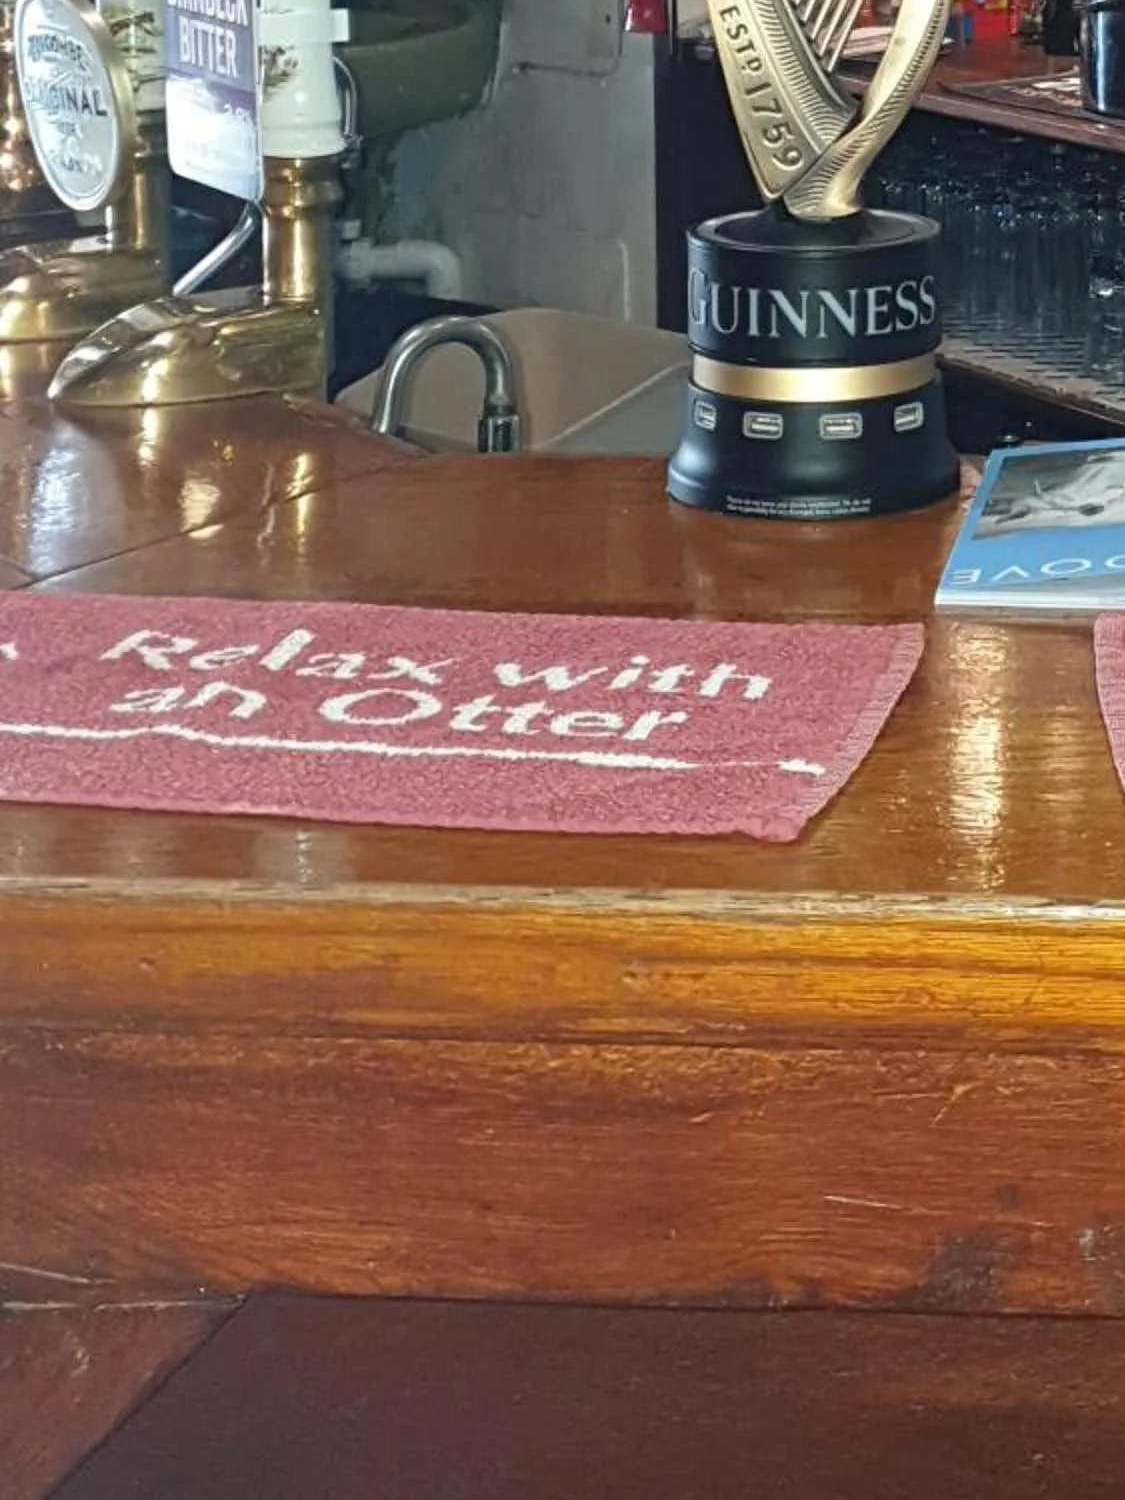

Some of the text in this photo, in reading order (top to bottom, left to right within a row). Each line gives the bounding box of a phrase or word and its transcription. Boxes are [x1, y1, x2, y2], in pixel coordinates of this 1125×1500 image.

[179, 15, 238, 78] BITTER
[745, 82, 805, 171] 1759
[690, 267, 936, 339] GUINNESS
[100, 628, 775, 702] Relax with
[110, 679, 691, 742] an Otter
